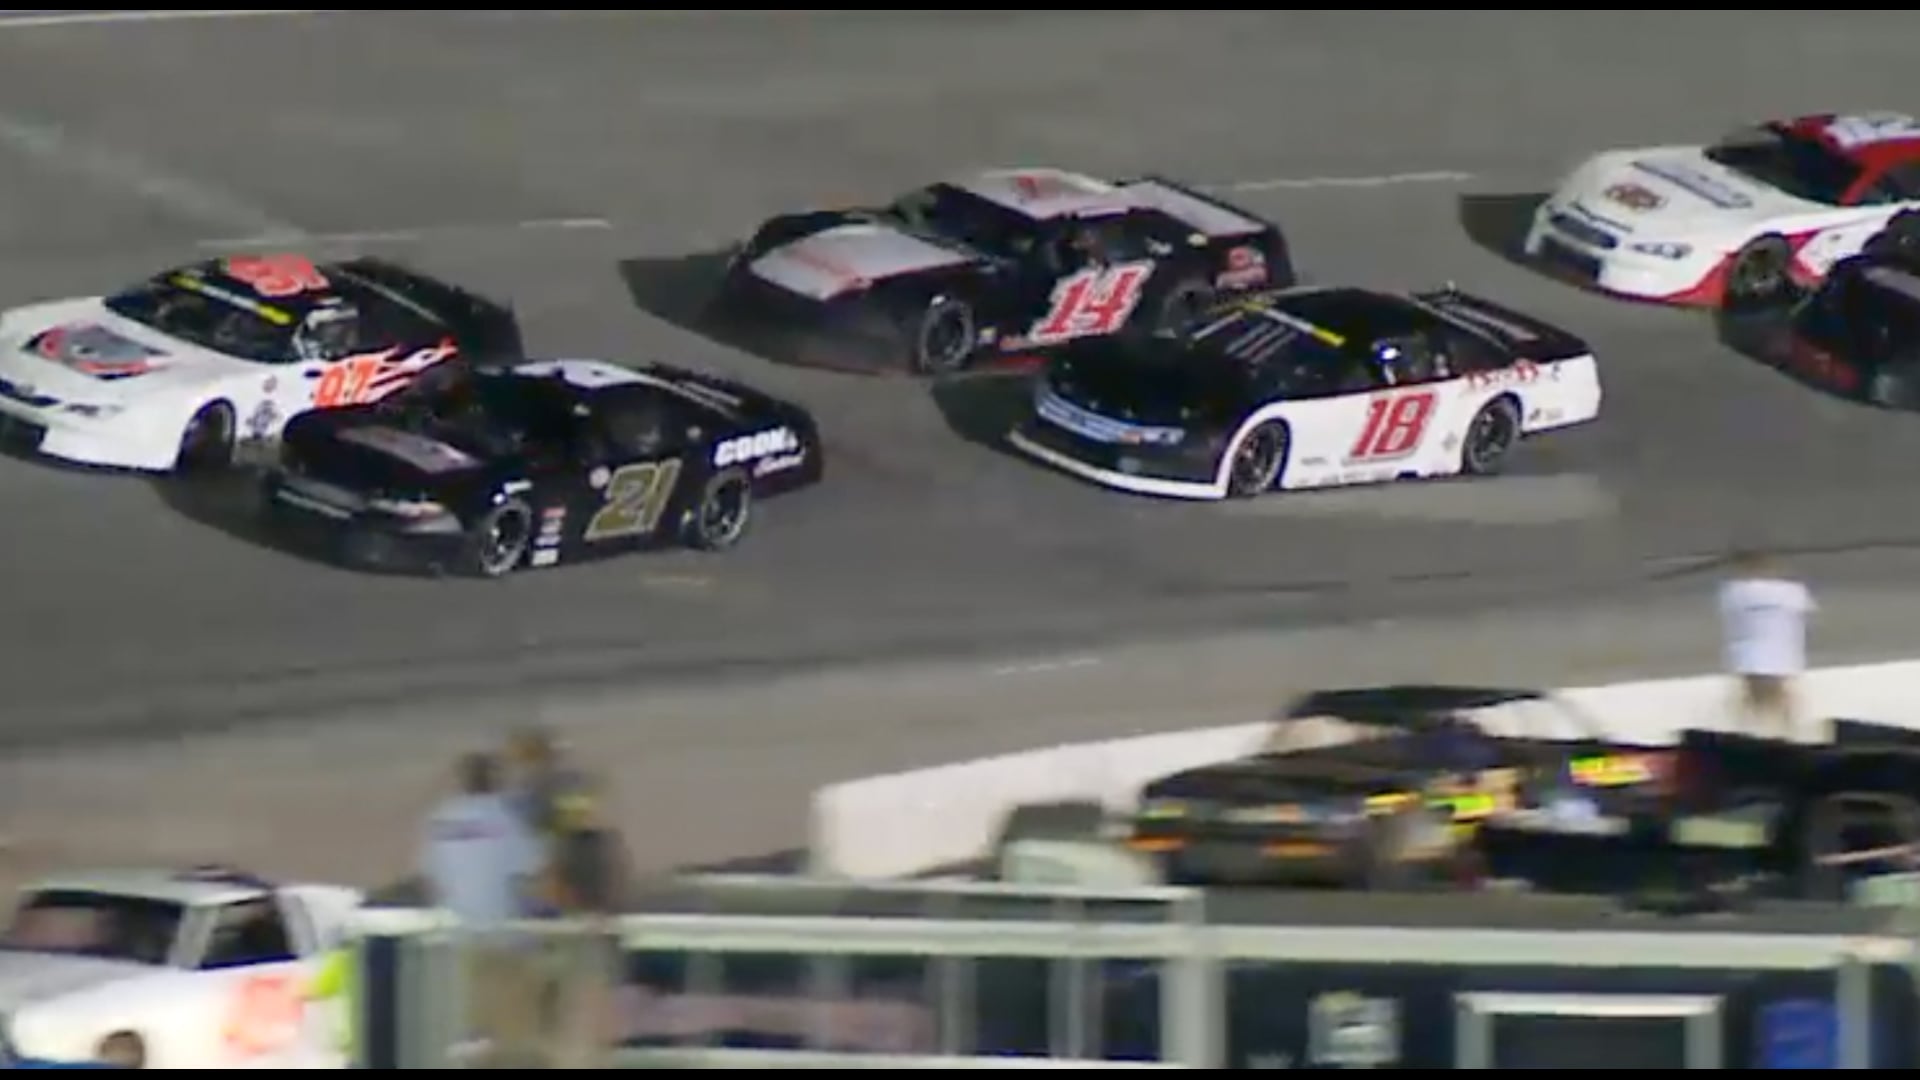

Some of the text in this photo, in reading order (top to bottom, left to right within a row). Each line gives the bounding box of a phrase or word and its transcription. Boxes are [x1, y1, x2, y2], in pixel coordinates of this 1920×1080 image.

[1029, 262, 1153, 340] 14
[1345, 390, 1436, 461] 18
[584, 459, 682, 540] 21
